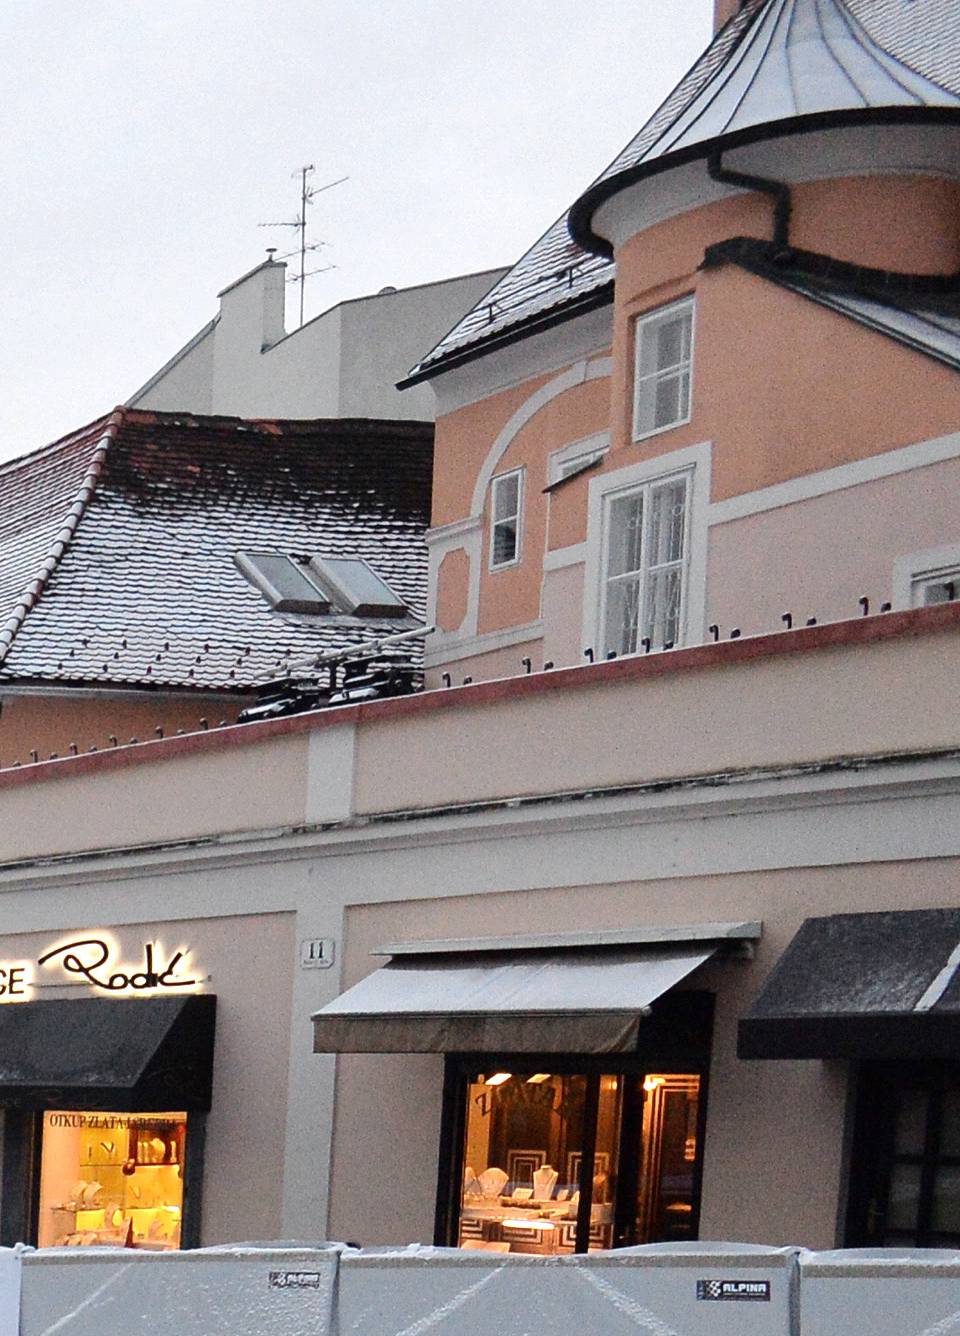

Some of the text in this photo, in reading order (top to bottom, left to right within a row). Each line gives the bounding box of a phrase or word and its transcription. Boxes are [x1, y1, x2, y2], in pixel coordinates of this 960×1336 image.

[310, 941, 323, 959] 11
[38, 939, 195, 989] Rodić
[49, 1113, 85, 1127] OTKUP
[88, 1114, 124, 1129] ZLATA
[722, 1283, 767, 1293] ALPINA
